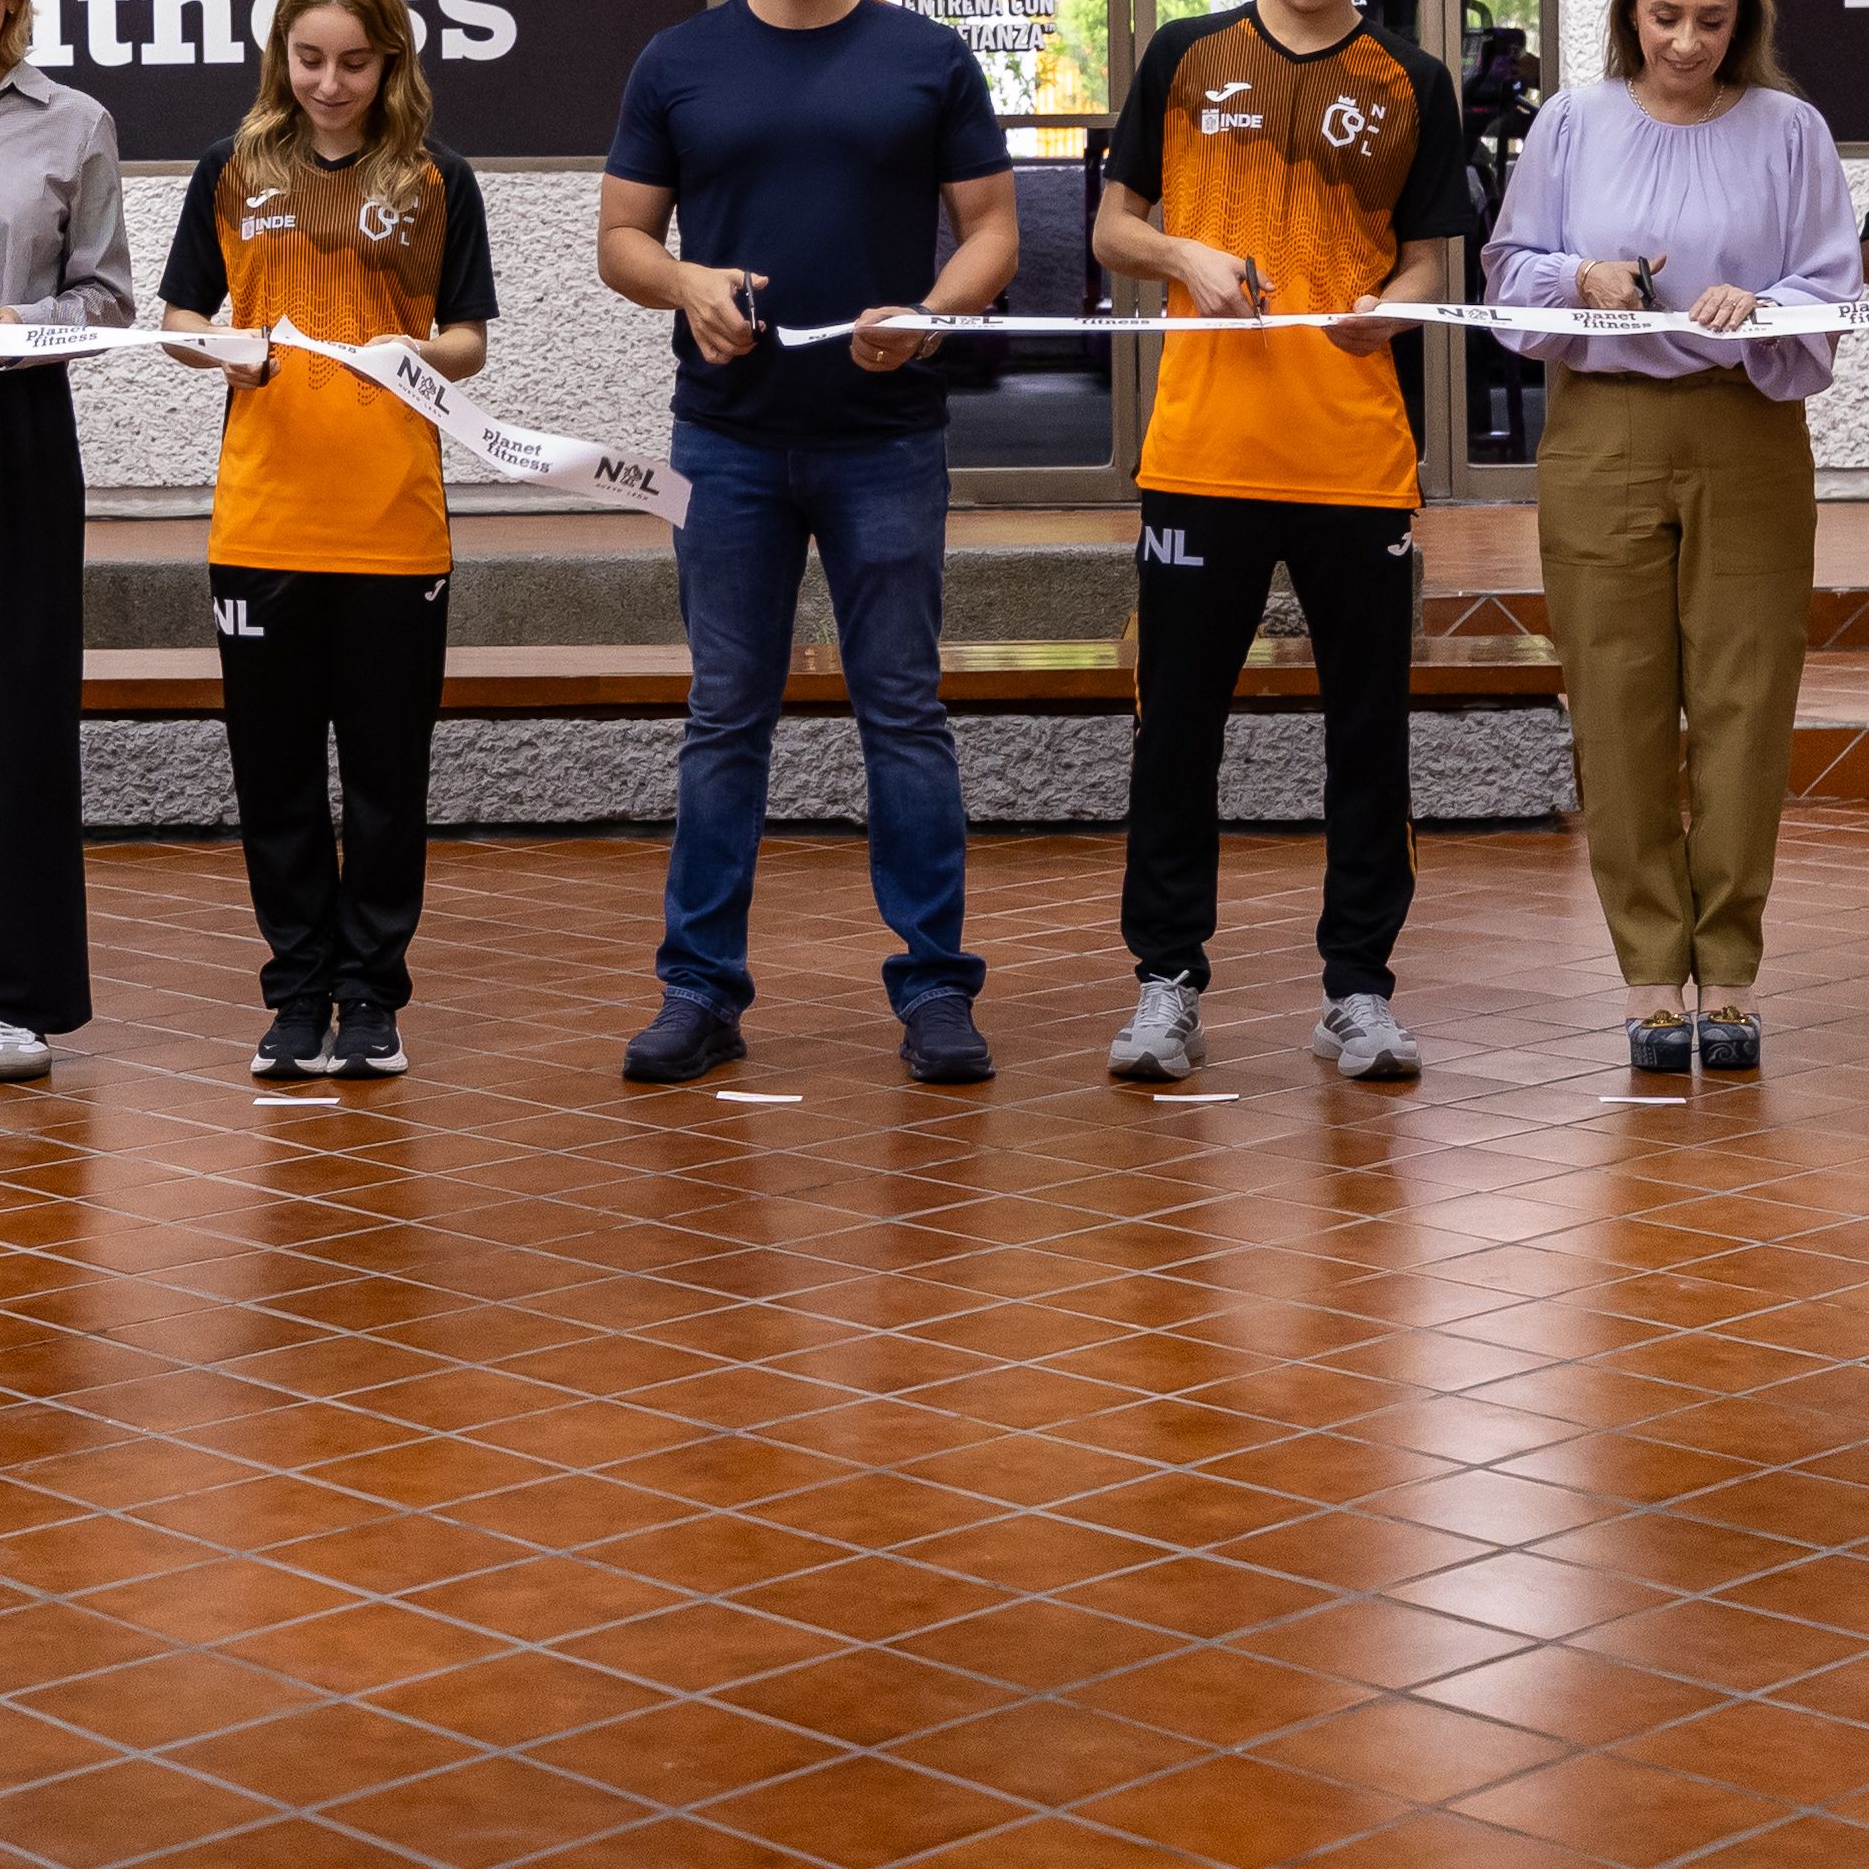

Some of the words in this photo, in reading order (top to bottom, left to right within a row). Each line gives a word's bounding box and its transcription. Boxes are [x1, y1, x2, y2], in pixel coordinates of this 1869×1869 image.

[1221, 113, 1263, 132] INDE
[256, 214, 296, 235] INDE
[1572, 311, 1637, 322] planet
[1583, 319, 1652, 329] fitness
[32, 333, 97, 348] fitness
[482, 428, 543, 456] planet
[487, 442, 551, 474] fitness
[1144, 526, 1204, 567] NL
[213, 596, 265, 636] NL
